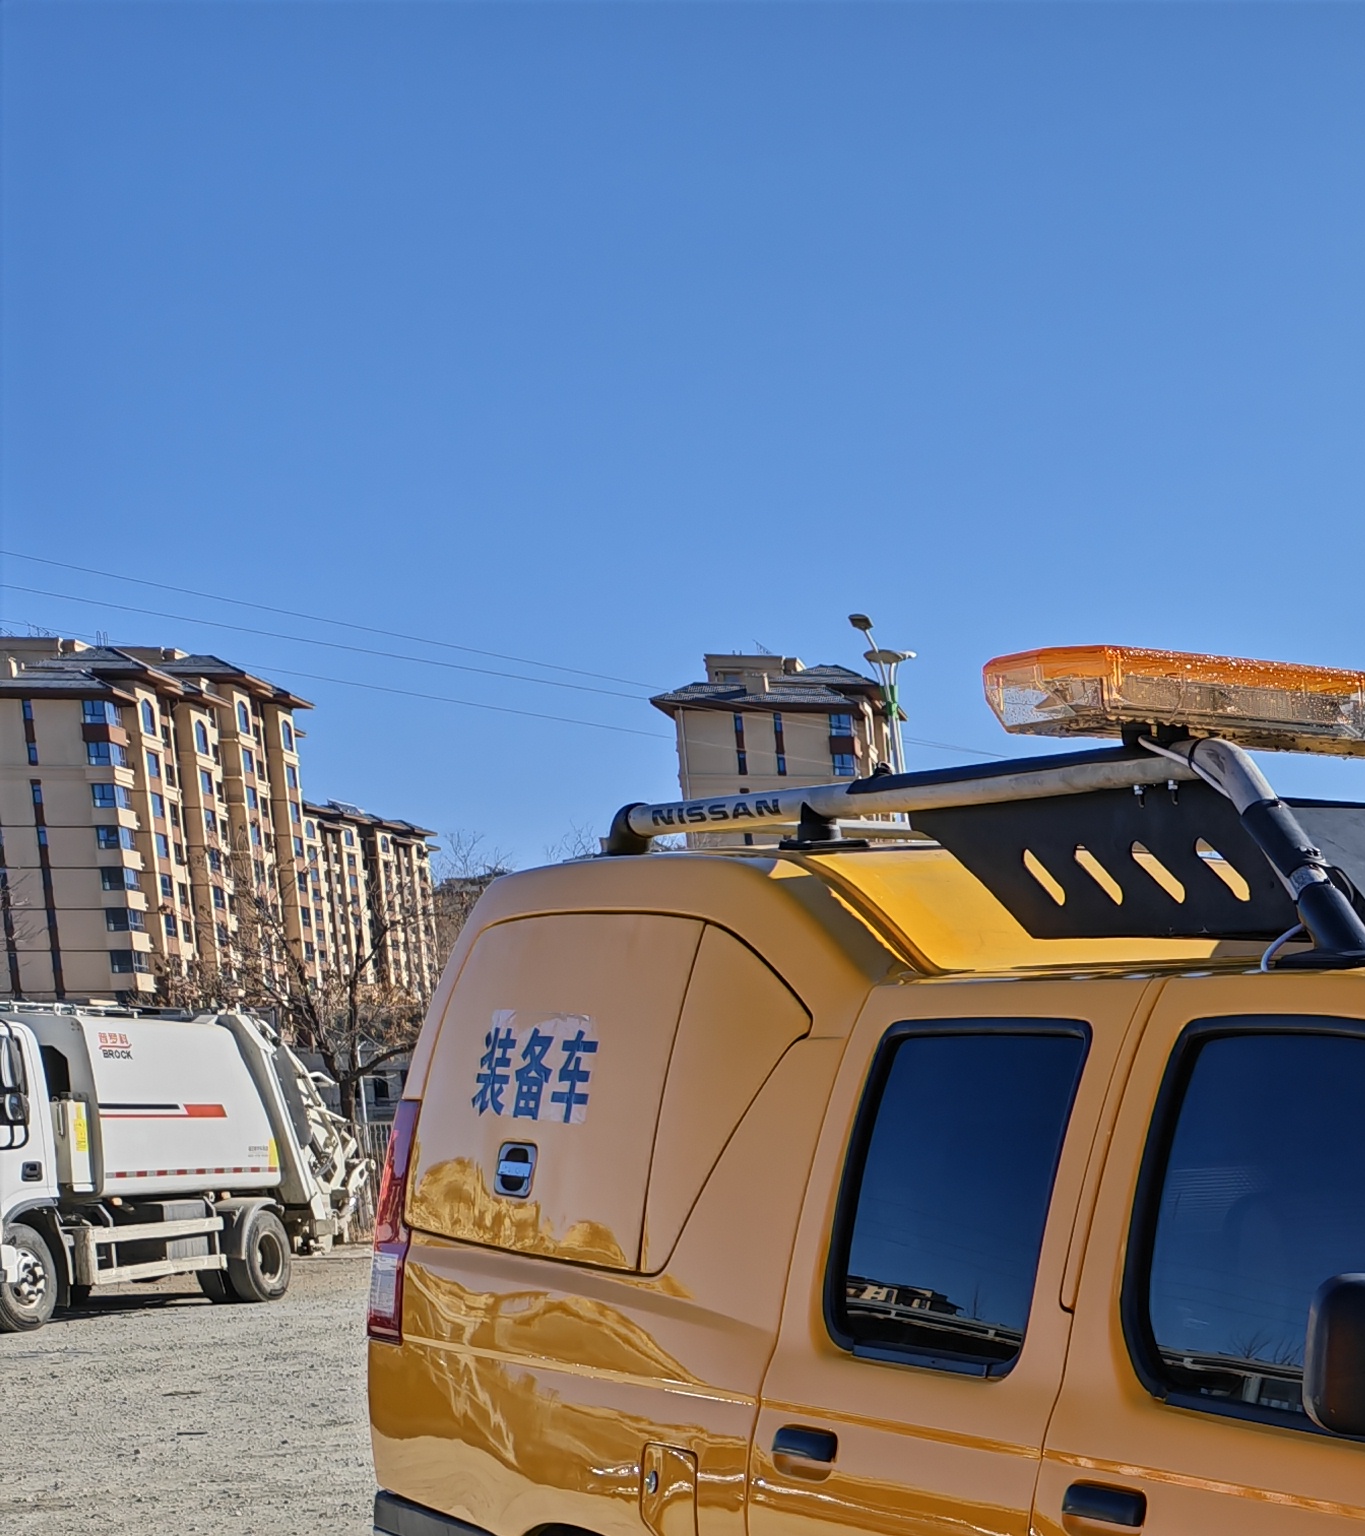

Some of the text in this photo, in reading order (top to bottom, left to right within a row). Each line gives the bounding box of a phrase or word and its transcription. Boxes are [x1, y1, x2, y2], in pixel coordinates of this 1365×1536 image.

[652, 798, 783, 827] NISSAN
[102, 1049, 134, 1060] BROCK
[471, 1026, 599, 1124] 装备车
